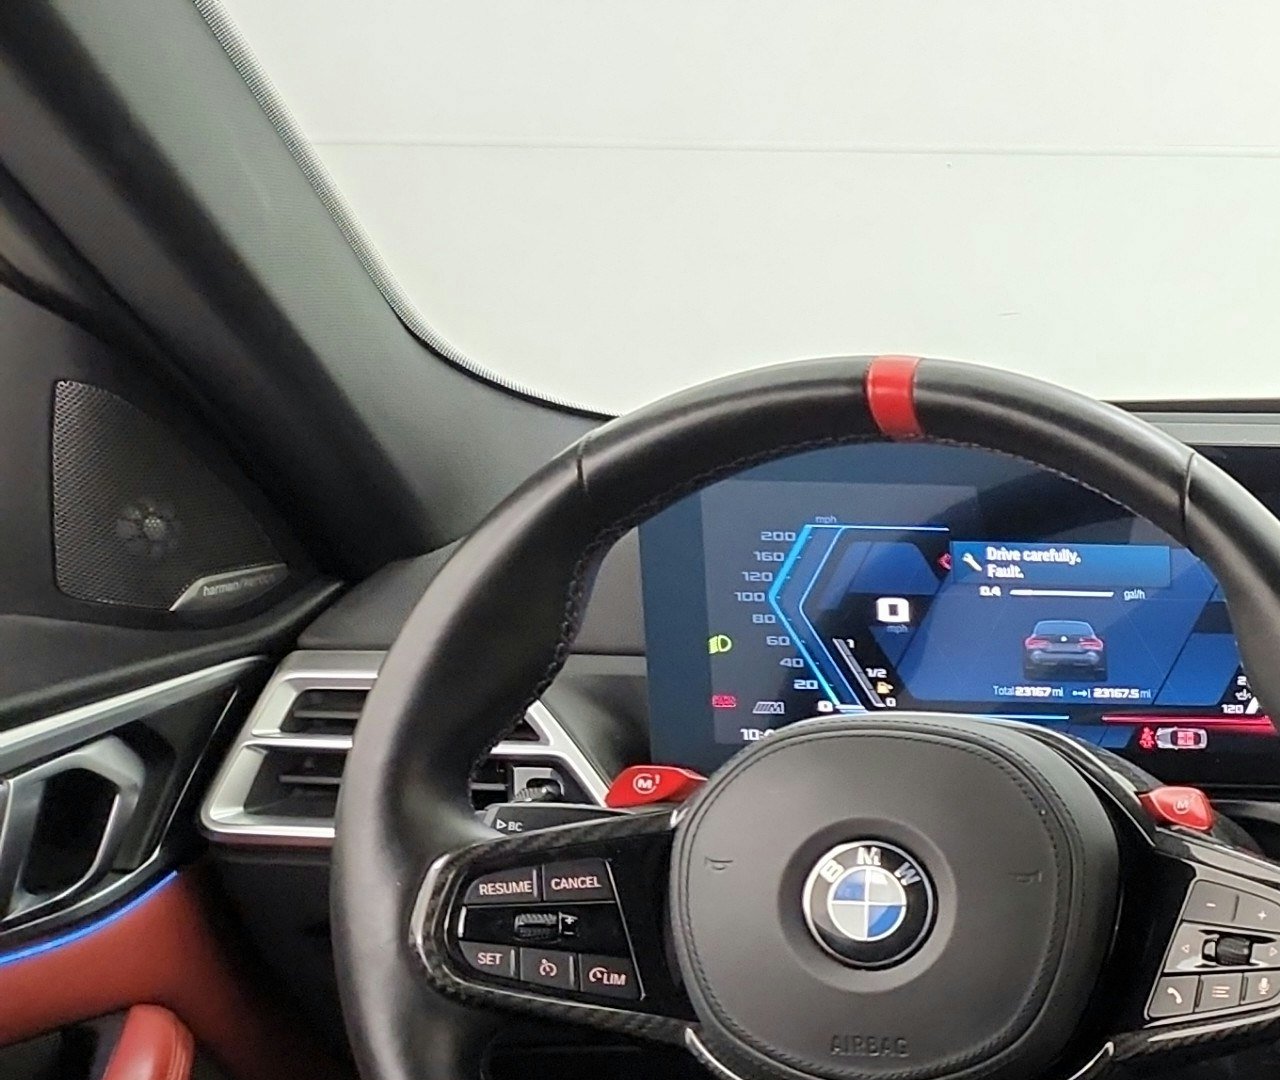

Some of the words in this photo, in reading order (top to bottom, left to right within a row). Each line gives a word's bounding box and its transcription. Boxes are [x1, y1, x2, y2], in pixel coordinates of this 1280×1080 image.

[760, 532, 796, 541] 200
[752, 551, 785, 562] 160
[986, 547, 1021, 561] Drive
[1023, 548, 1082, 565] carefully.
[741, 571, 773, 582] 120
[986, 564, 1025, 579] Fault.
[734, 592, 766, 602] 100
[875, 597, 910, 623] 0
[752, 614, 776, 624] 80
[766, 636, 790, 646] 60
[779, 658, 804, 668] 40
[865, 667, 887, 678] 1/2
[793, 680, 819, 690] 20
[992, 685, 1014, 696] Total
[1014, 686, 1052, 697] 23167
[1221, 703, 1244, 714] 120
[508, 821, 523, 832] BC
[820, 846, 922, 887] BMW
[479, 880, 533, 896] RESUME
[551, 875, 602, 890] CANCEL
[477, 952, 503, 965] SET
[602, 971, 626, 986] LIM
[830, 1034, 910, 1058] AIRBAG
